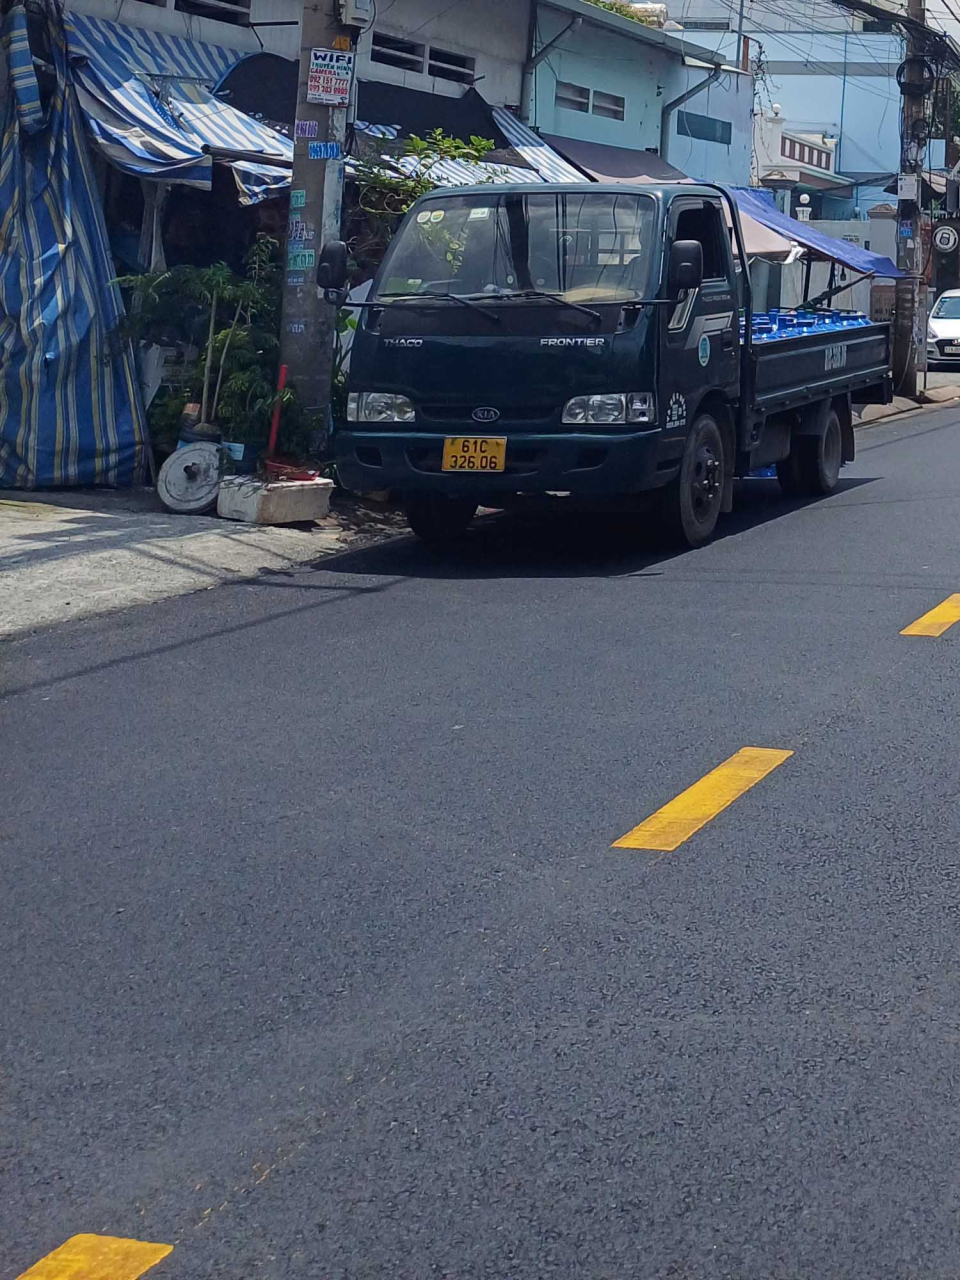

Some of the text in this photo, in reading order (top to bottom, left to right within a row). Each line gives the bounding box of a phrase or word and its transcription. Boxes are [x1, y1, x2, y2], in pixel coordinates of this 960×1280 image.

[313, 51, 353, 65] WIFI
[310, 67, 337, 77] CAMERA
[383, 338, 605, 348] THACO FRONTIER
[476, 410, 495, 419] KIA
[461, 439, 489, 454] 61C
[449, 454, 498, 470] 326.06
